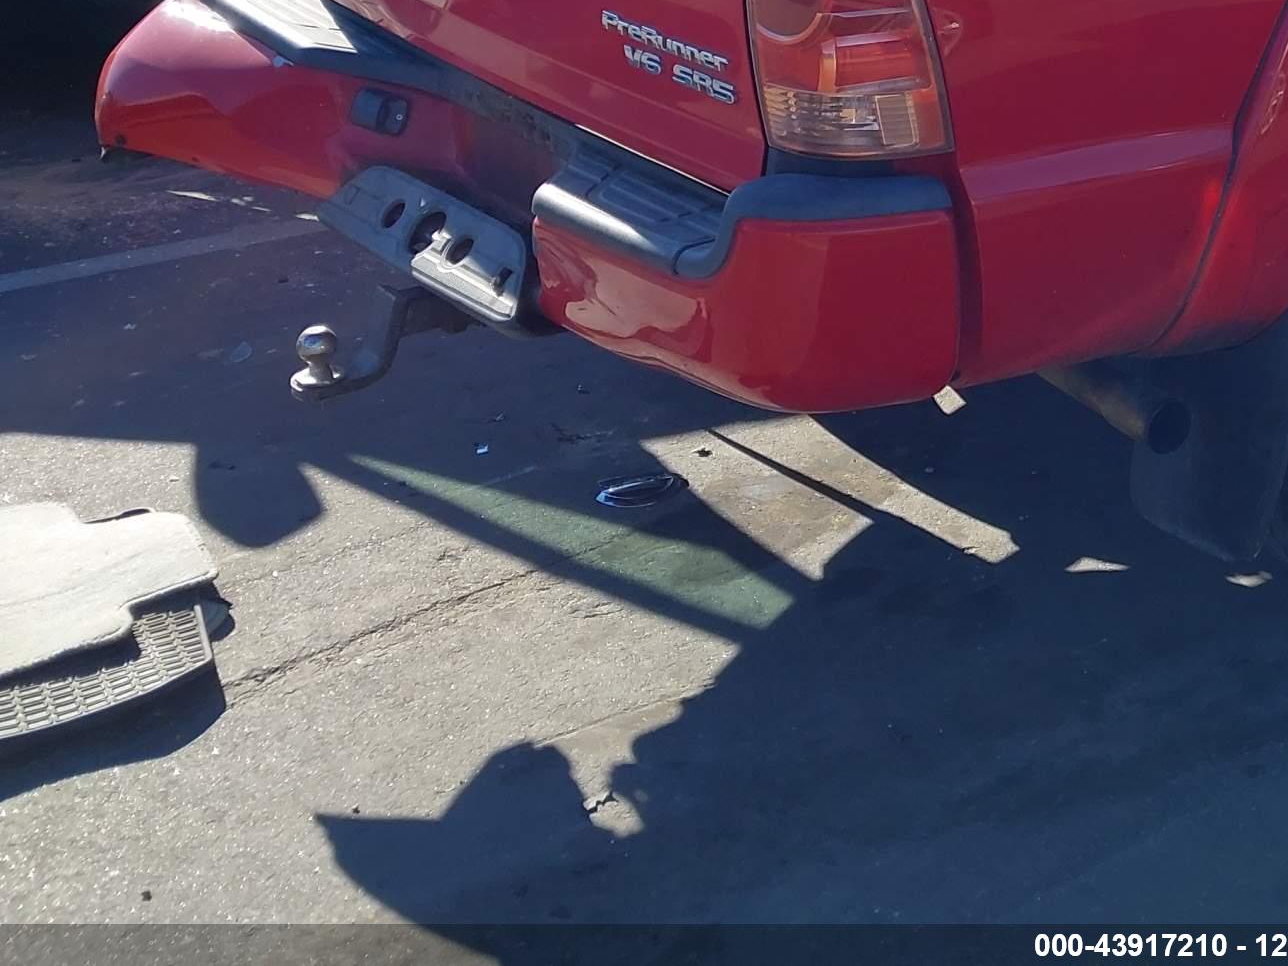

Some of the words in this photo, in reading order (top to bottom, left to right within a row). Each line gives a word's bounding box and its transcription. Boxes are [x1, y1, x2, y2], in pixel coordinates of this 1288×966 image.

[601, 10, 729, 72] PreRunner
[623, 45, 662, 75] V6
[671, 64, 736, 105] SR5
